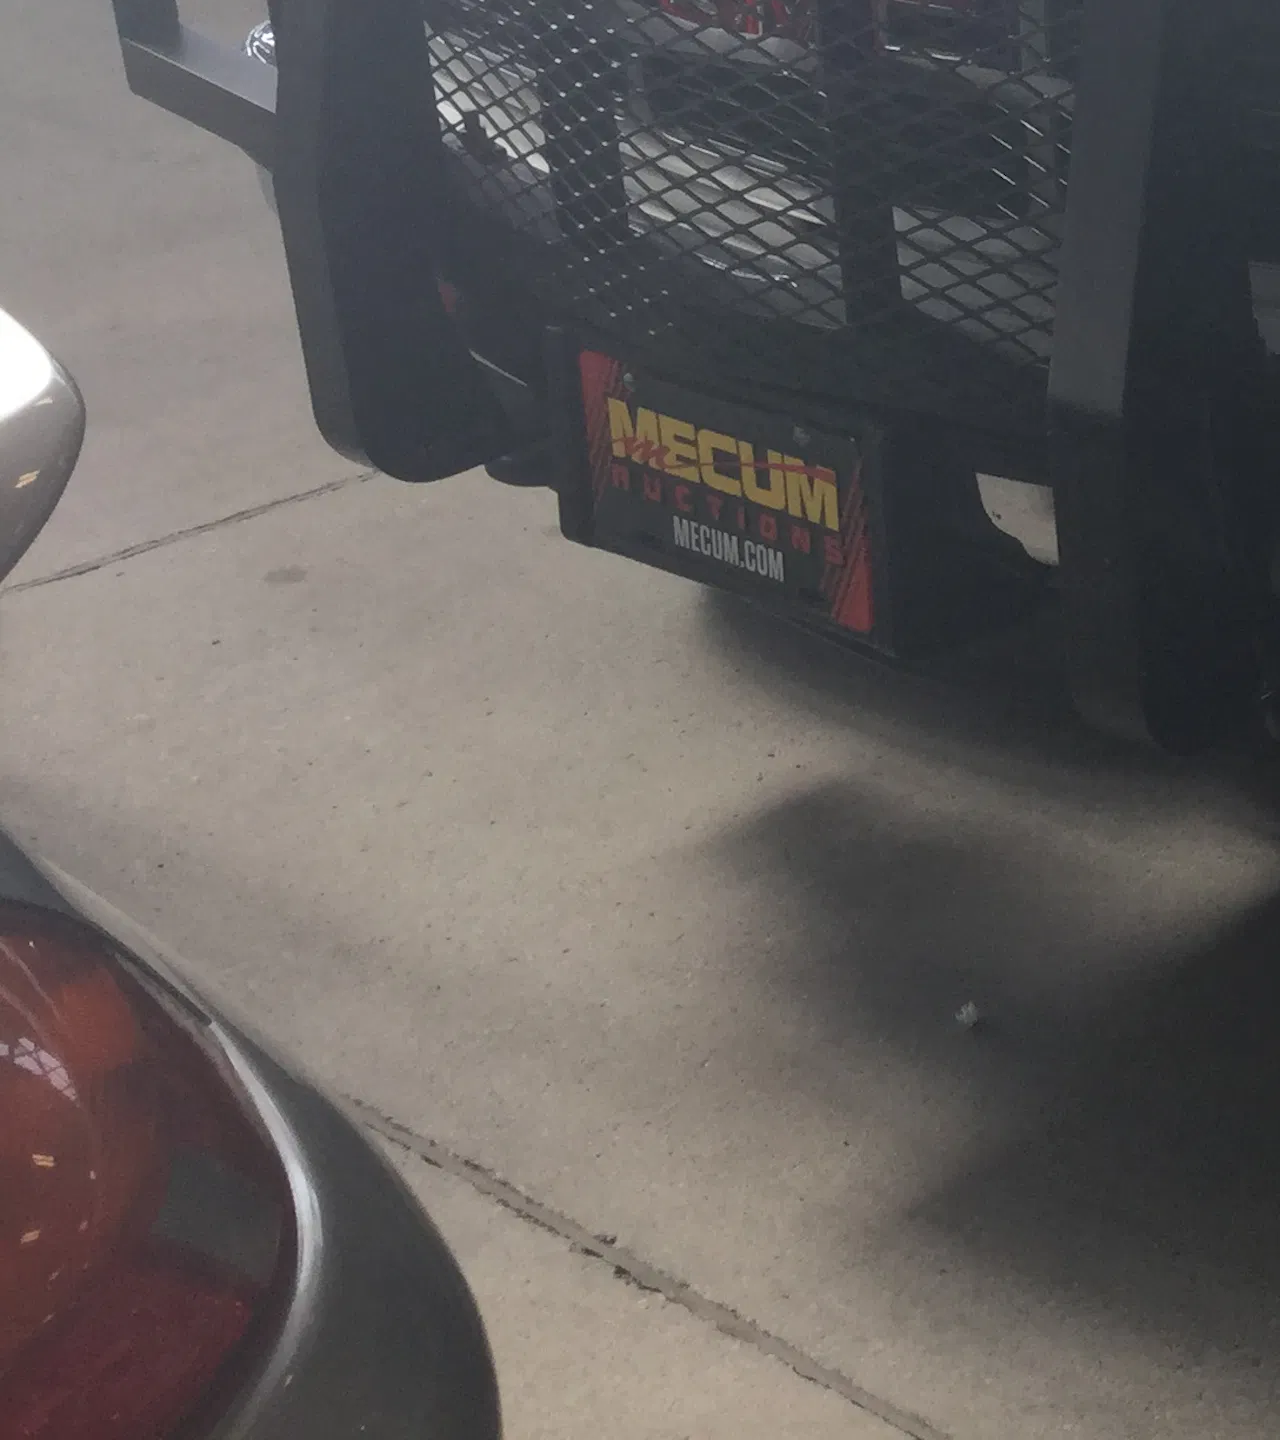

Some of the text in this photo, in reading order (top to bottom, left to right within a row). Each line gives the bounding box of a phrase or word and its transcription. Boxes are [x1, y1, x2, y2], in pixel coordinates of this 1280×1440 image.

[607, 396, 840, 532] MECUM
[610, 462, 846, 566] AUCTIONS
[672, 514, 785, 583] MECUM.COM
